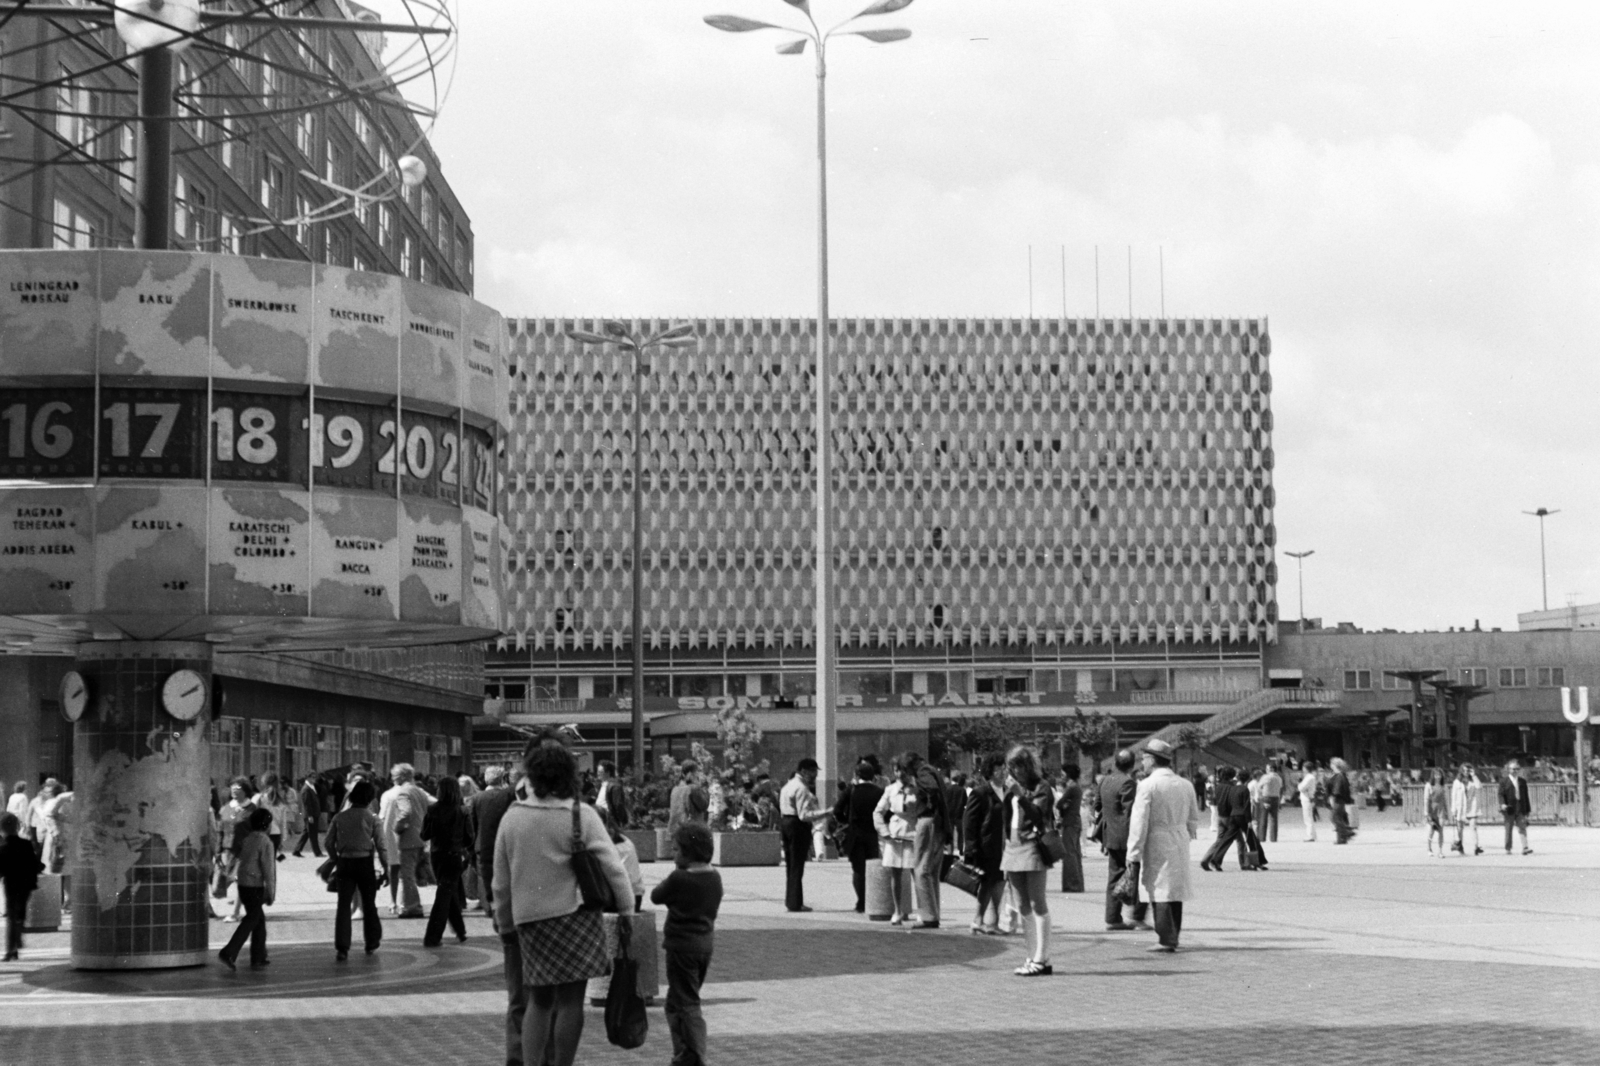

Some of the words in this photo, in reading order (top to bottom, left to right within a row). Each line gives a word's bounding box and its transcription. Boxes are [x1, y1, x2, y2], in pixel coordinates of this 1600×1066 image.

[10, 281, 80, 292] LENINGRAD
[20, 294, 70, 304] MOSKAU
[138, 294, 174, 305] BAKU
[227, 298, 298, 314] SWERDLOWSK
[329, 308, 386, 325] TASCHKENT
[2, 401, 74, 459] 16
[103, 402, 181, 458] 17
[210, 406, 278, 464] 18
[302, 413, 364, 469] 19
[377, 420, 435, 480] 20
[17, 507, 63, 518] BAGDAD
[13, 520, 66, 530] TEHERAN
[131, 520, 173, 531] KABUL
[229, 522, 291, 534] KARATSCHI
[243, 534, 278, 546] DELHI
[335, 539, 376, 551] RANGUN
[2, 545, 36, 555] ADDIS
[39, 545, 75, 555] ABEBA
[234, 546, 285, 558] COLOMBO
[341, 563, 371, 575] DACCA
[901, 692, 1047, 707] MARKT
[1561, 686, 1588, 723] U
